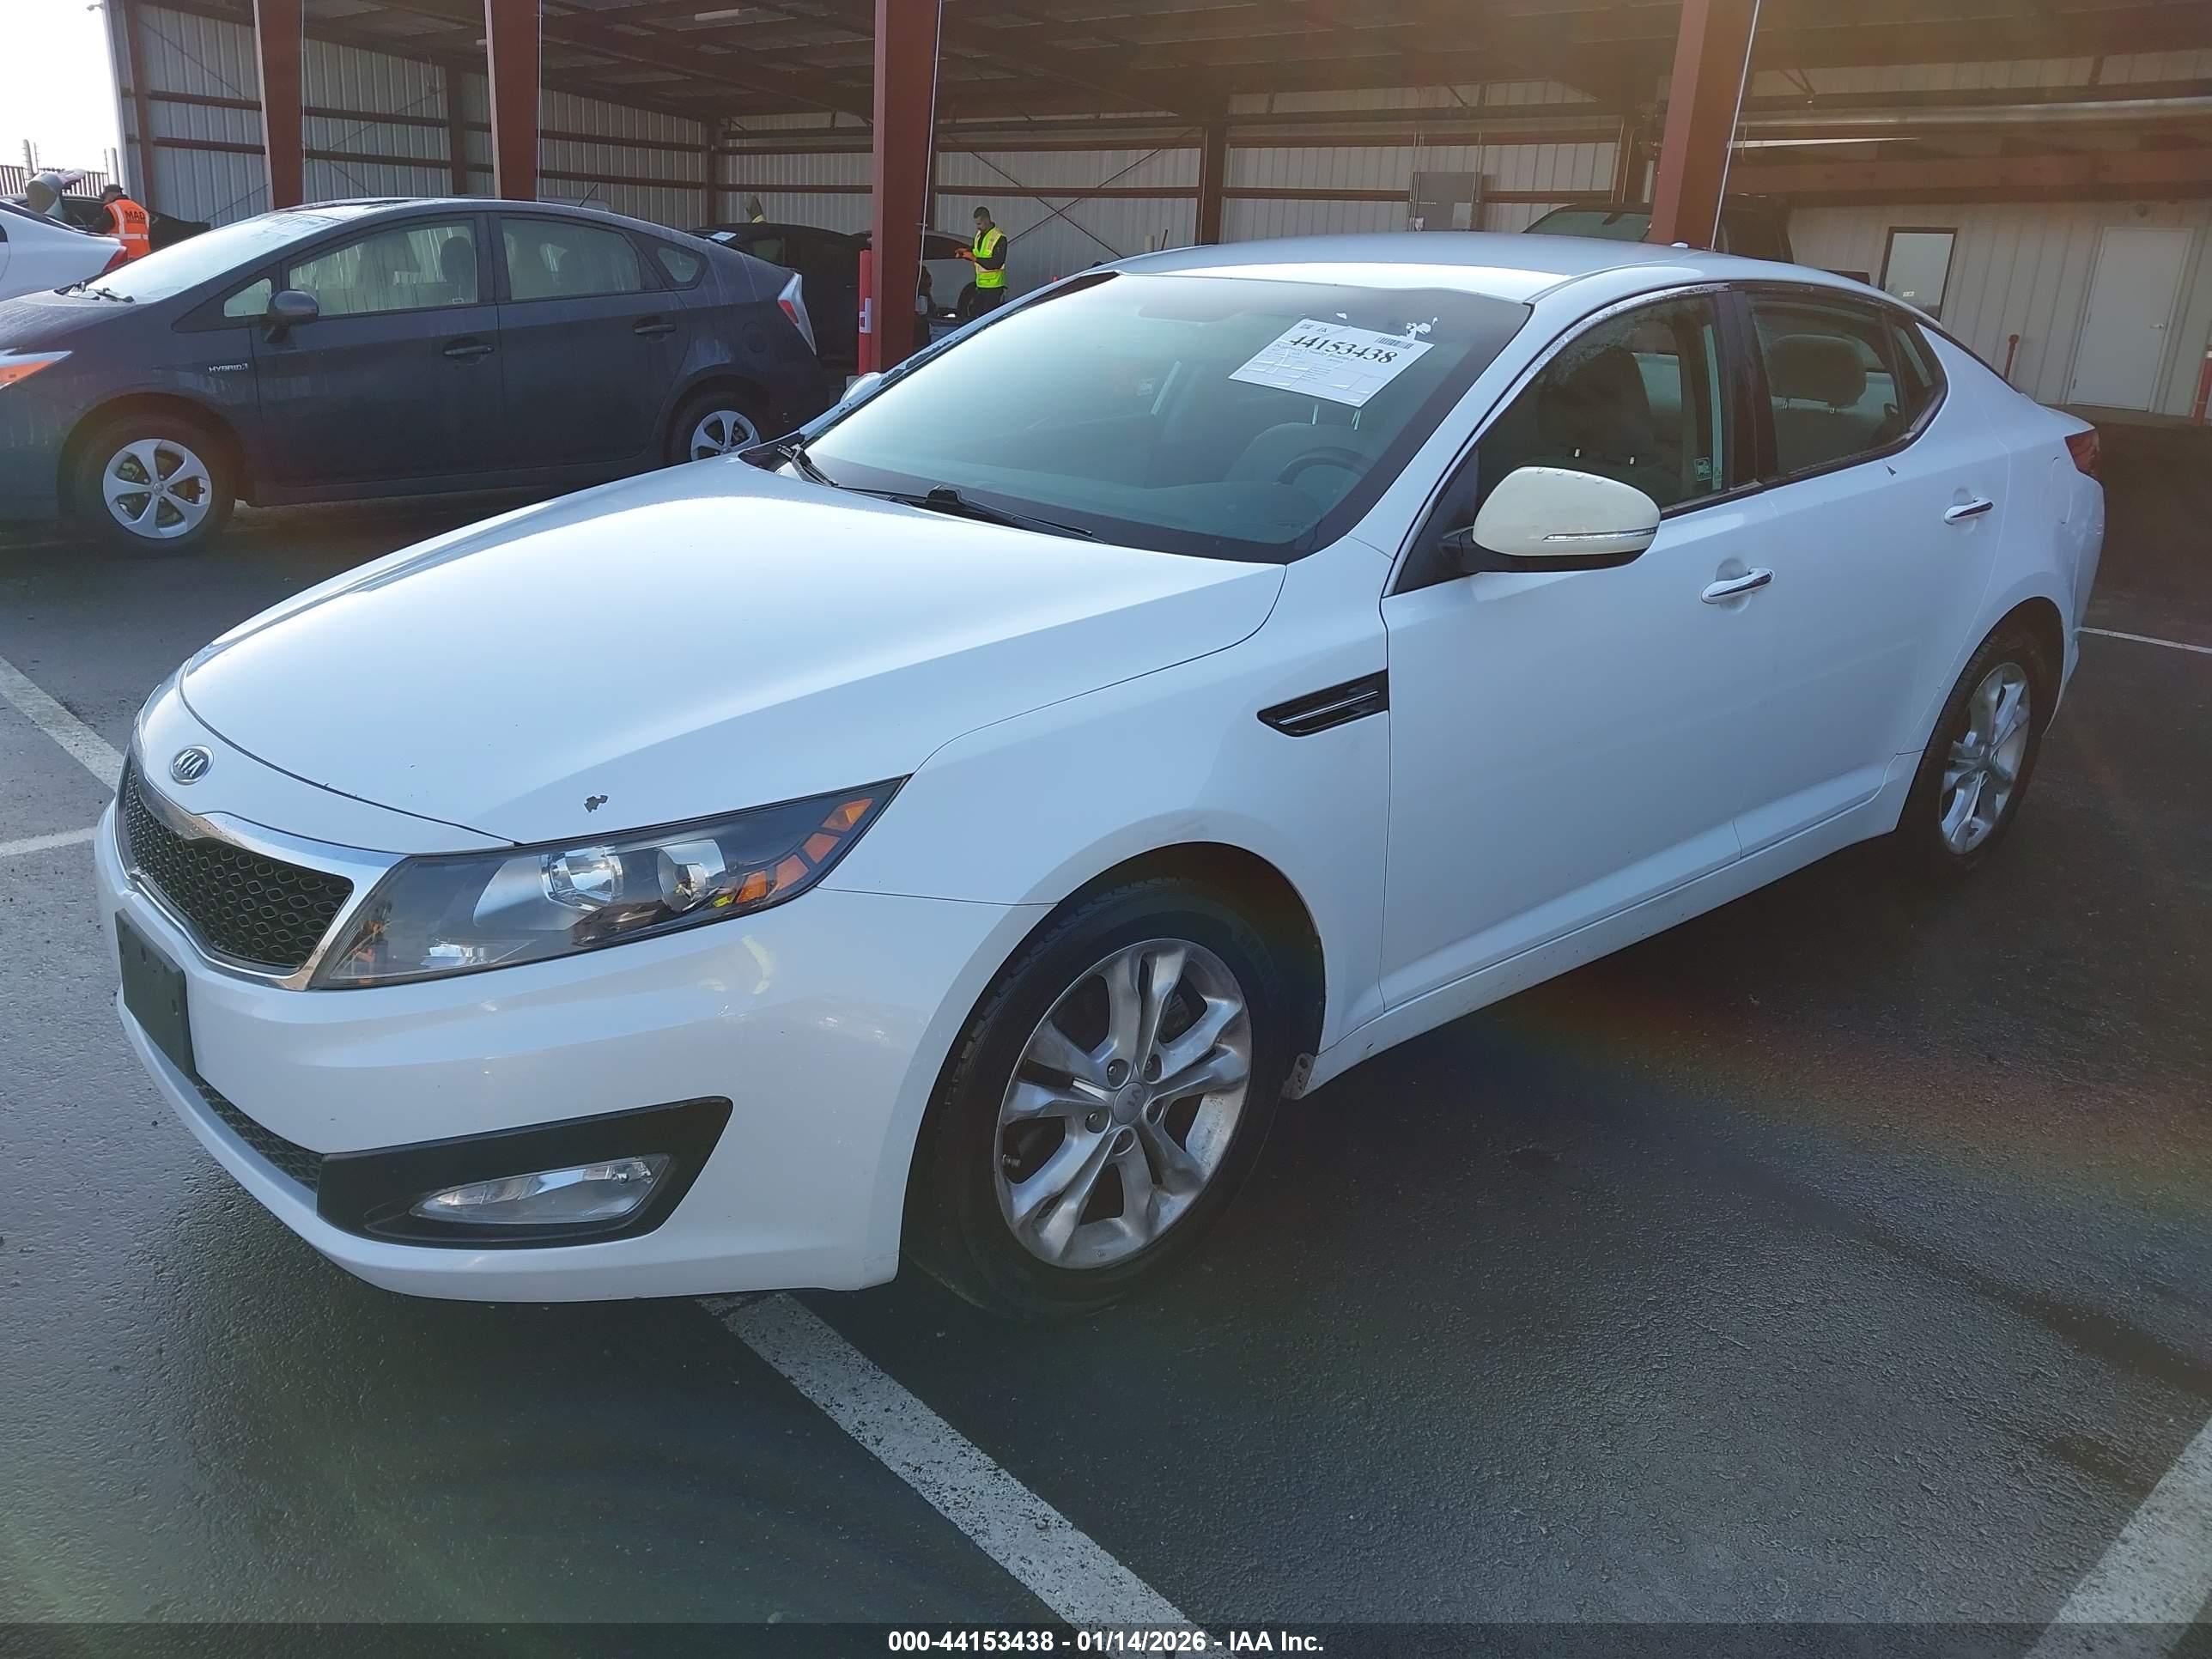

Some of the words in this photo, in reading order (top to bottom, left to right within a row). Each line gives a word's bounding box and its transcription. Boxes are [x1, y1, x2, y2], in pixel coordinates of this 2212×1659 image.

[1290, 335, 1398, 364] 44153438
[208, 364, 242, 373] HYBRID
[173, 748, 205, 778] KIA
